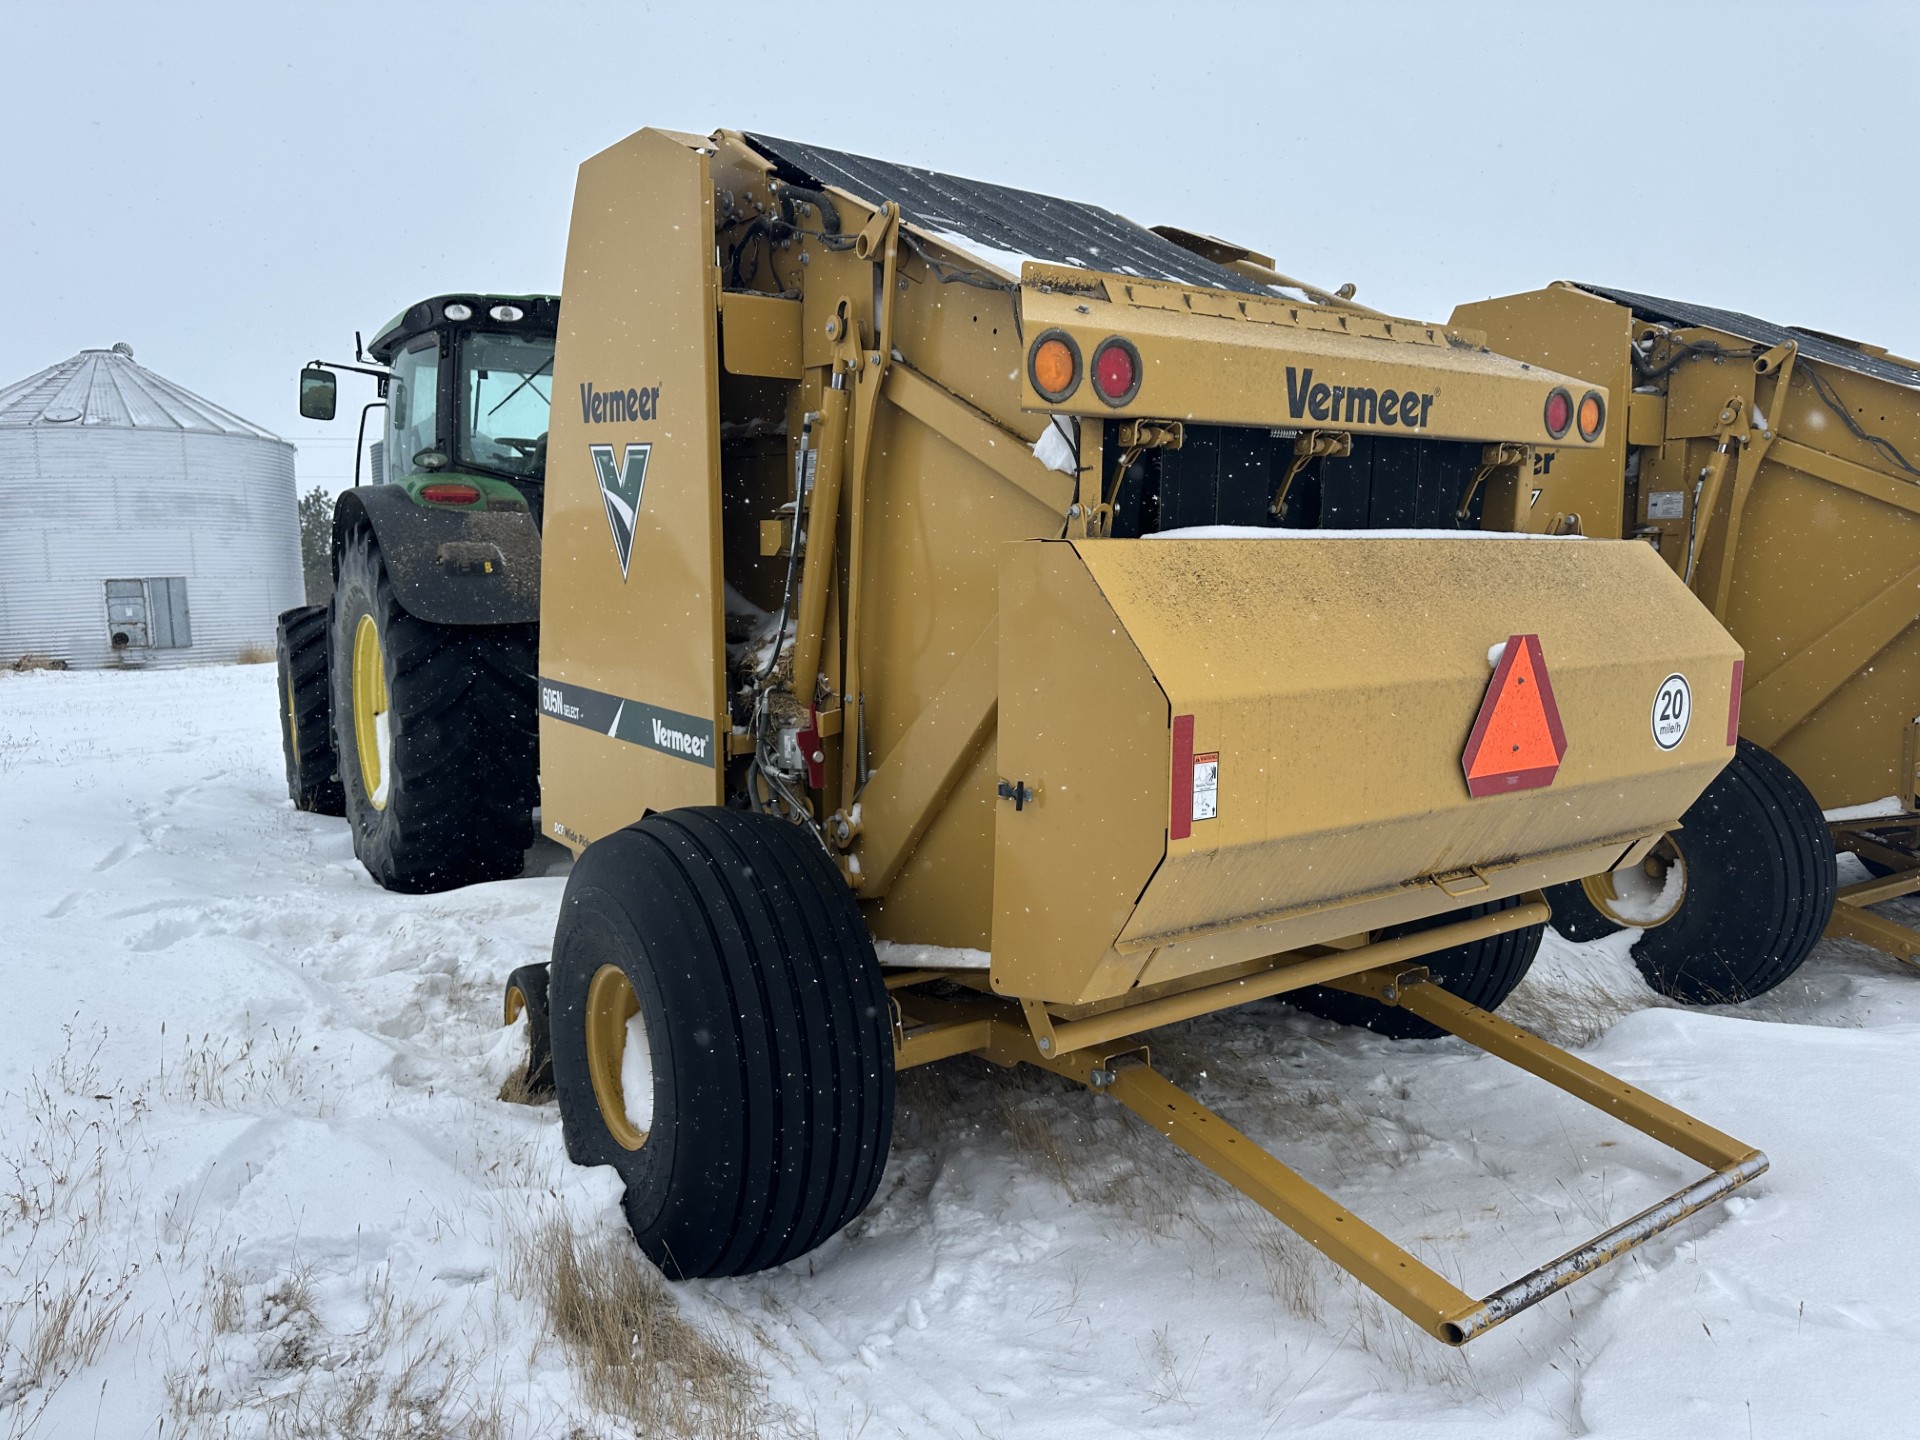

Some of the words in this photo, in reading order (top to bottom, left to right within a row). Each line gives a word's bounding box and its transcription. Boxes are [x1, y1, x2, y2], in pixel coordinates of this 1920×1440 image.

[580, 382, 660, 424] Vermeer
[1285, 366, 1434, 428] Vermeer
[543, 687, 563, 715] 605N
[563, 704, 579, 720] SELECT
[1659, 689, 1683, 721] 20
[652, 718, 706, 758] Vermeer
[1660, 722, 1681, 735] mile/h
